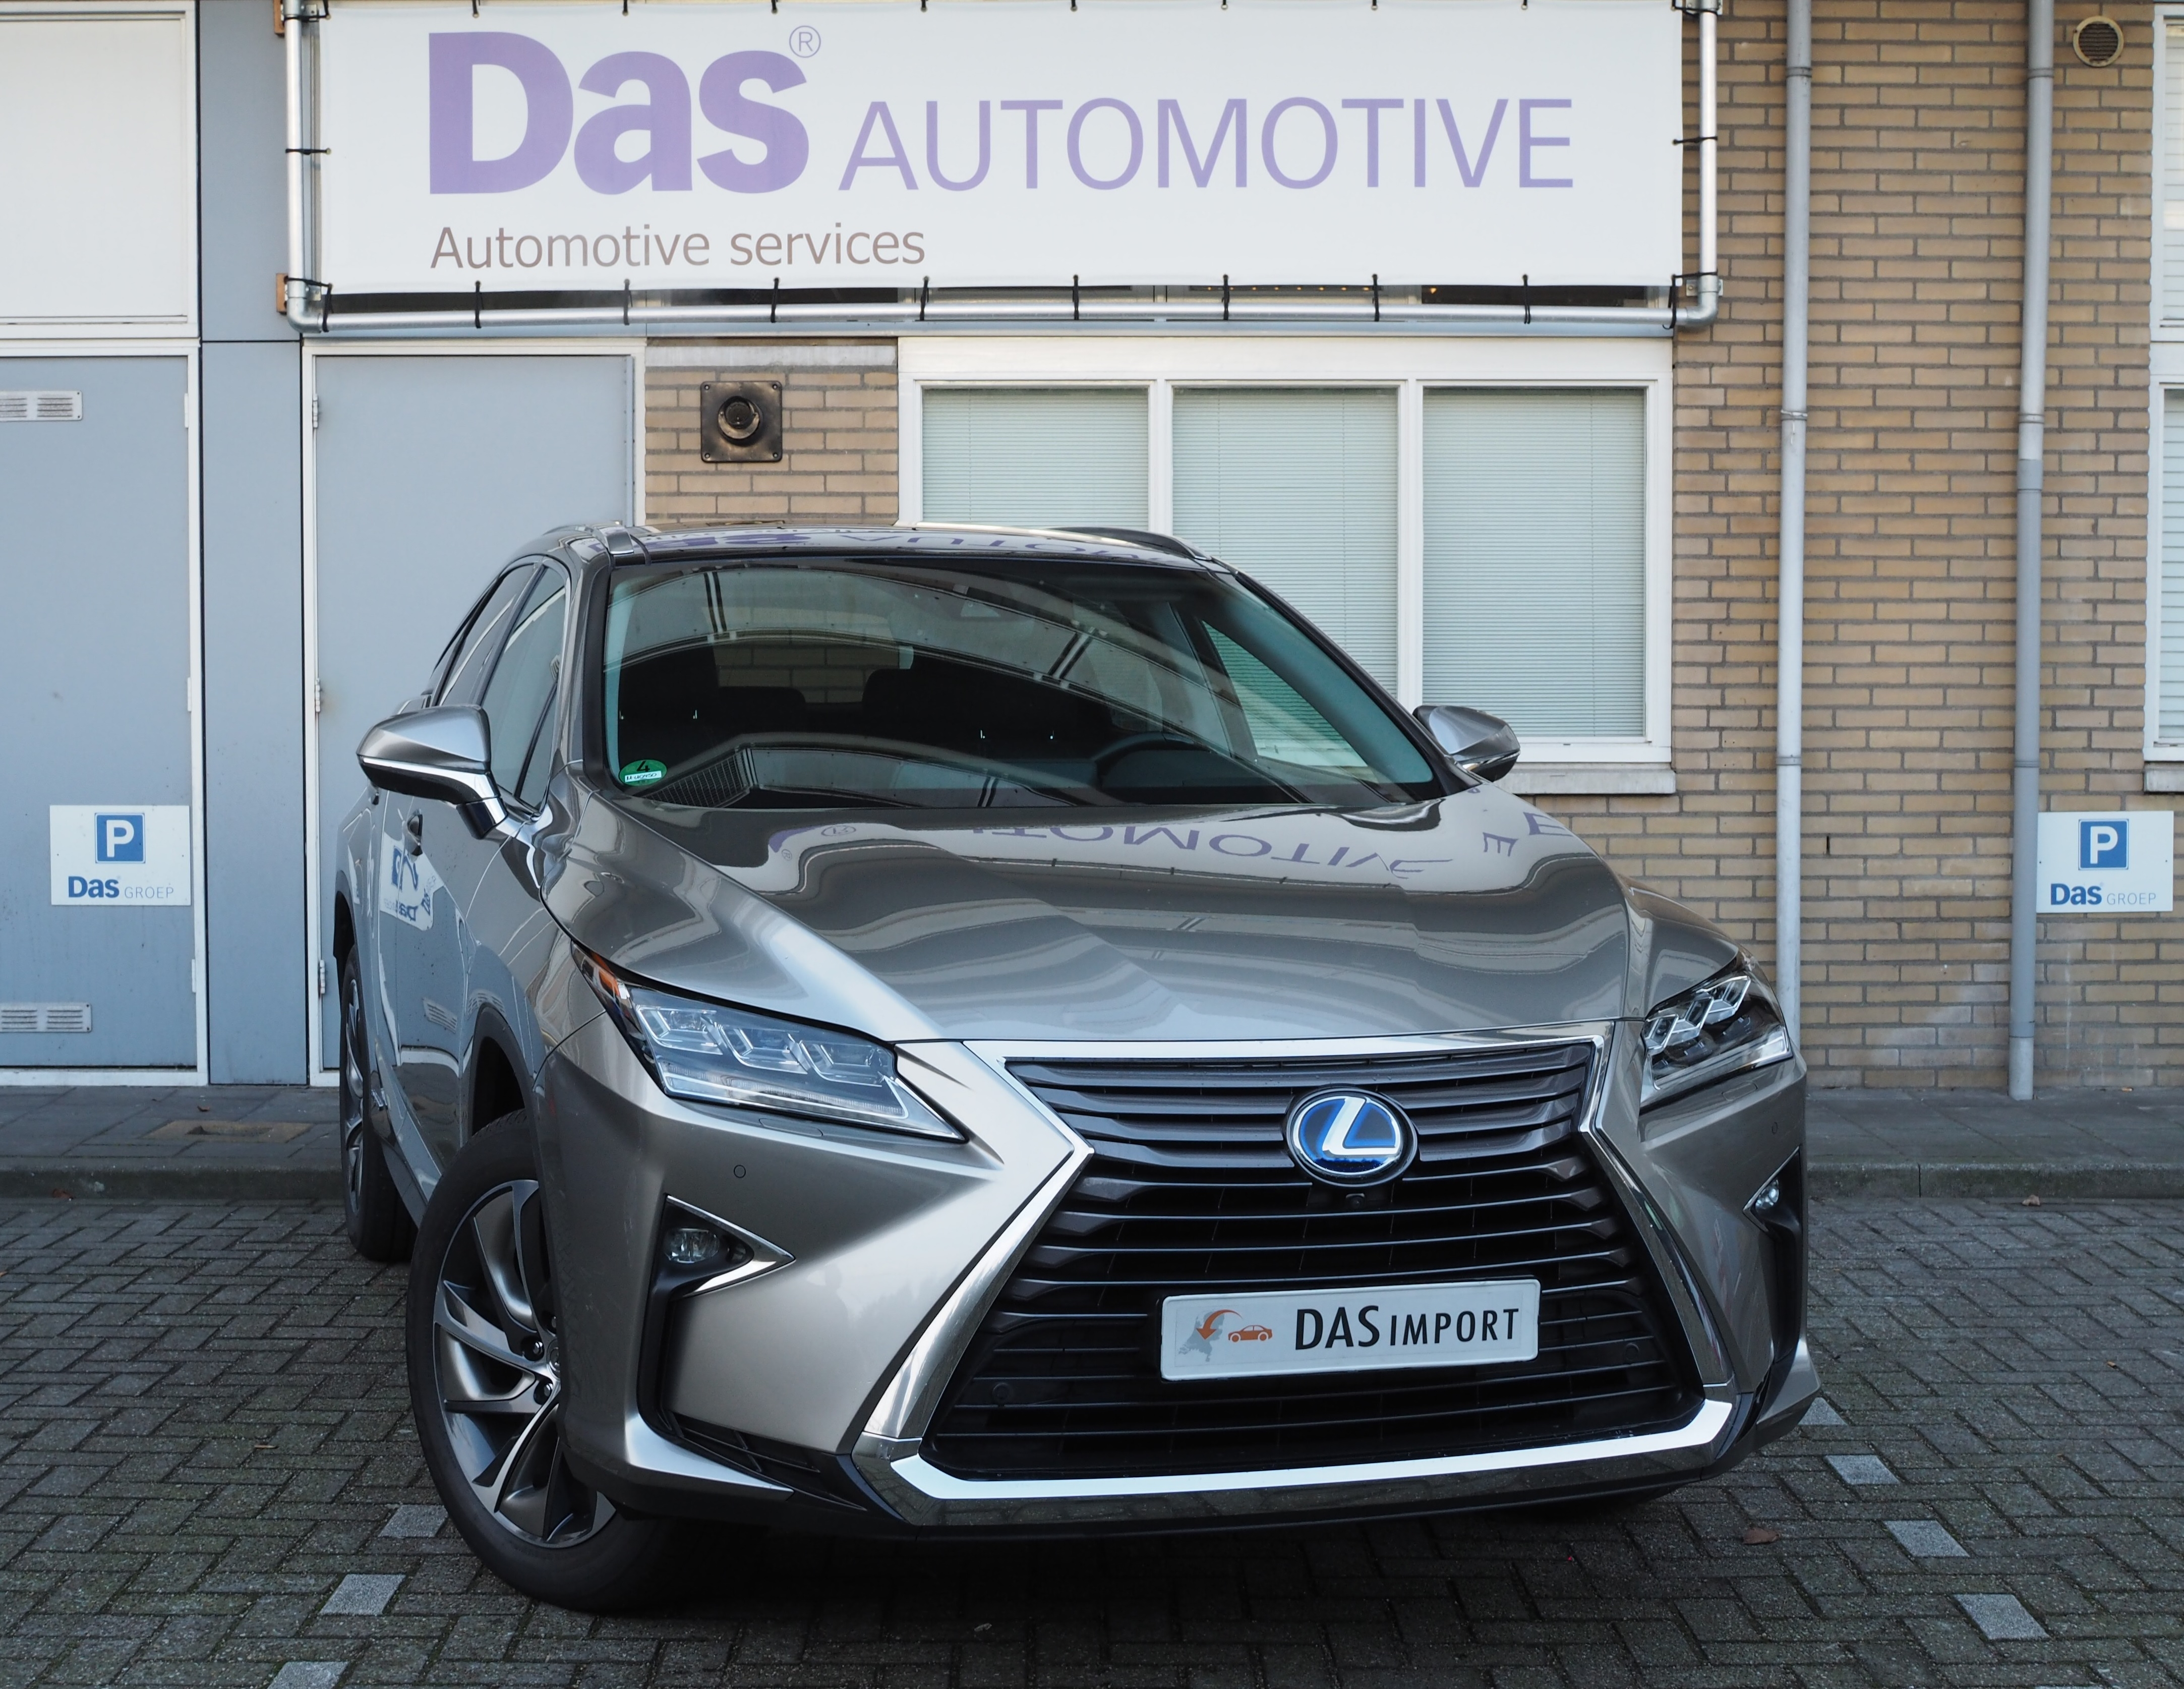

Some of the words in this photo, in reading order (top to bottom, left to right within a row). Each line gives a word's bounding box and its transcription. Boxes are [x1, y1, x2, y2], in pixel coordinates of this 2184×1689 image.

[838, 96, 1574, 191] AUTOMOTIVE
[430, 224, 710, 268] Automotive
[730, 222, 925, 265] services
[636, 760, 650, 772] 4
[106, 820, 134, 857] P
[2090, 826, 2118, 864] P
[68, 876, 120, 899] Das
[124, 887, 174, 899] GROEP
[2050, 883, 2102, 906] Das
[2106, 893, 2156, 905] GROEP
[1295, 1305, 1380, 1350] DAS
[1389, 1308, 1519, 1346] IMPORT
